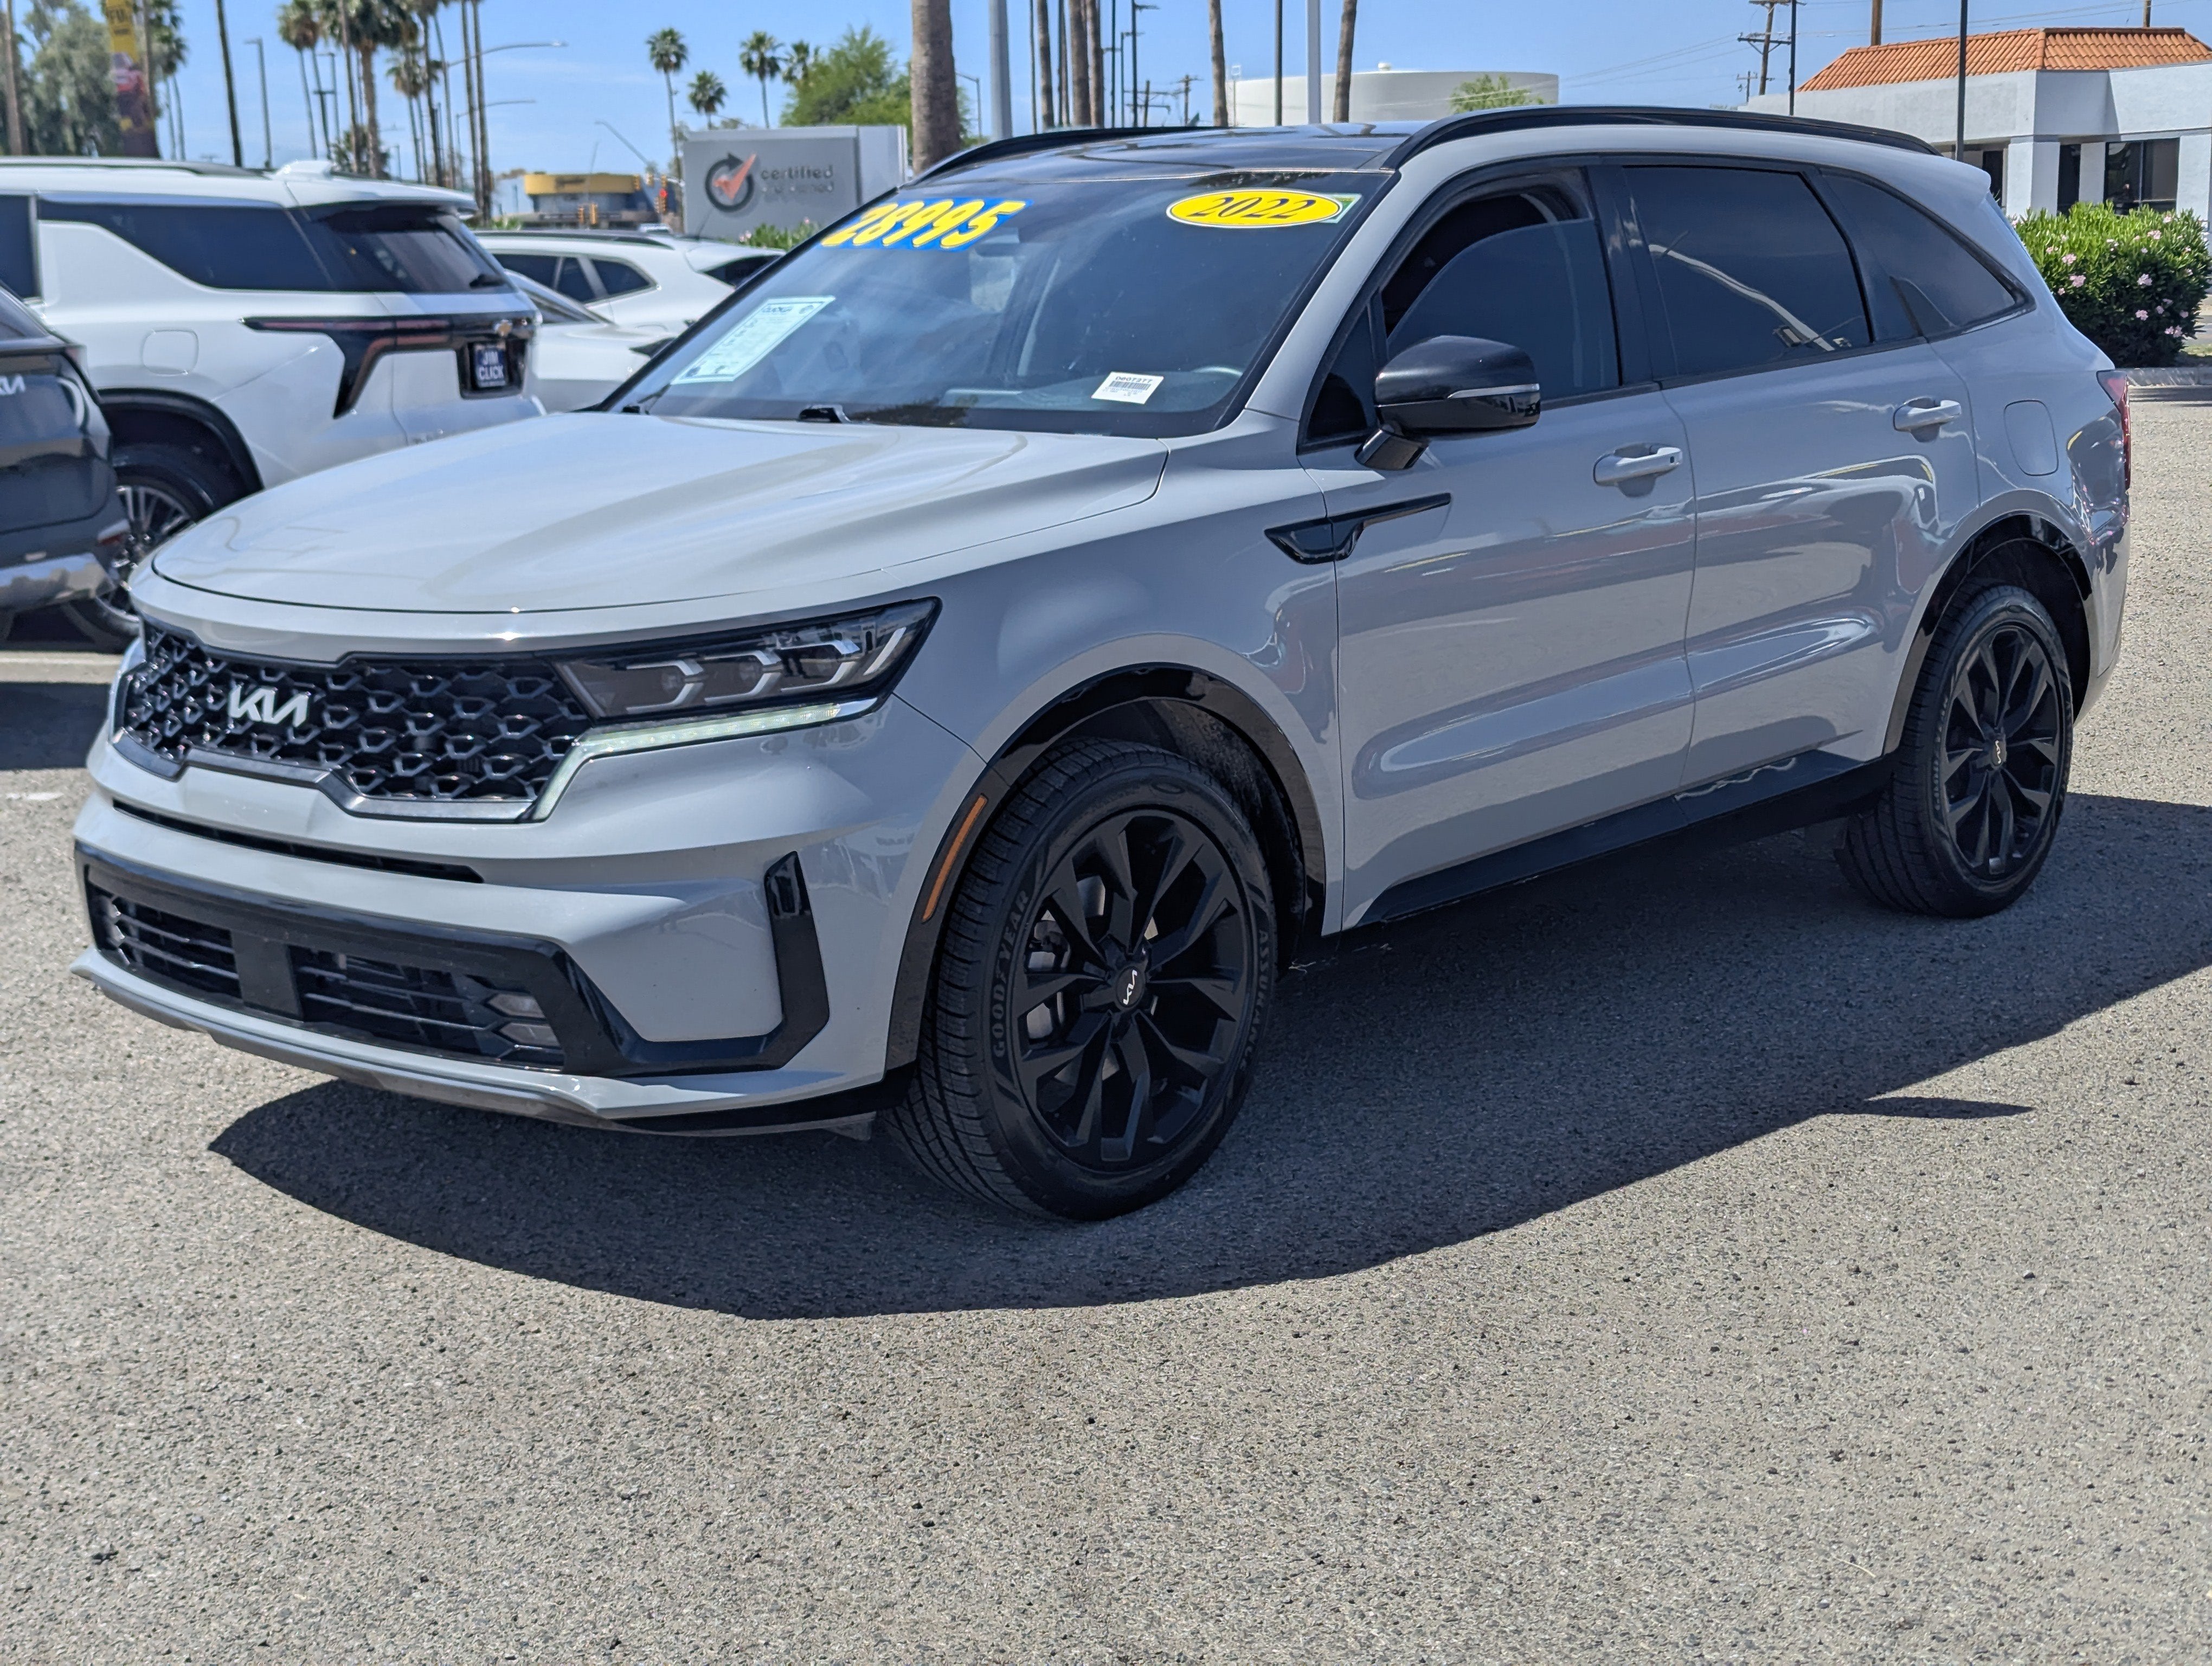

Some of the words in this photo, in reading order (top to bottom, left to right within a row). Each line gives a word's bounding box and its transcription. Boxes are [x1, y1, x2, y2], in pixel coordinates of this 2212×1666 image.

[761, 165, 833, 180] certified
[1185, 196, 1316, 220] 2022
[821, 200, 1026, 248] 28995
[482, 350, 499, 365] JIM
[478, 365, 505, 380] CLICK
[229, 684, 310, 728] KIA
[992, 890, 1030, 1058] GOODYEAR
